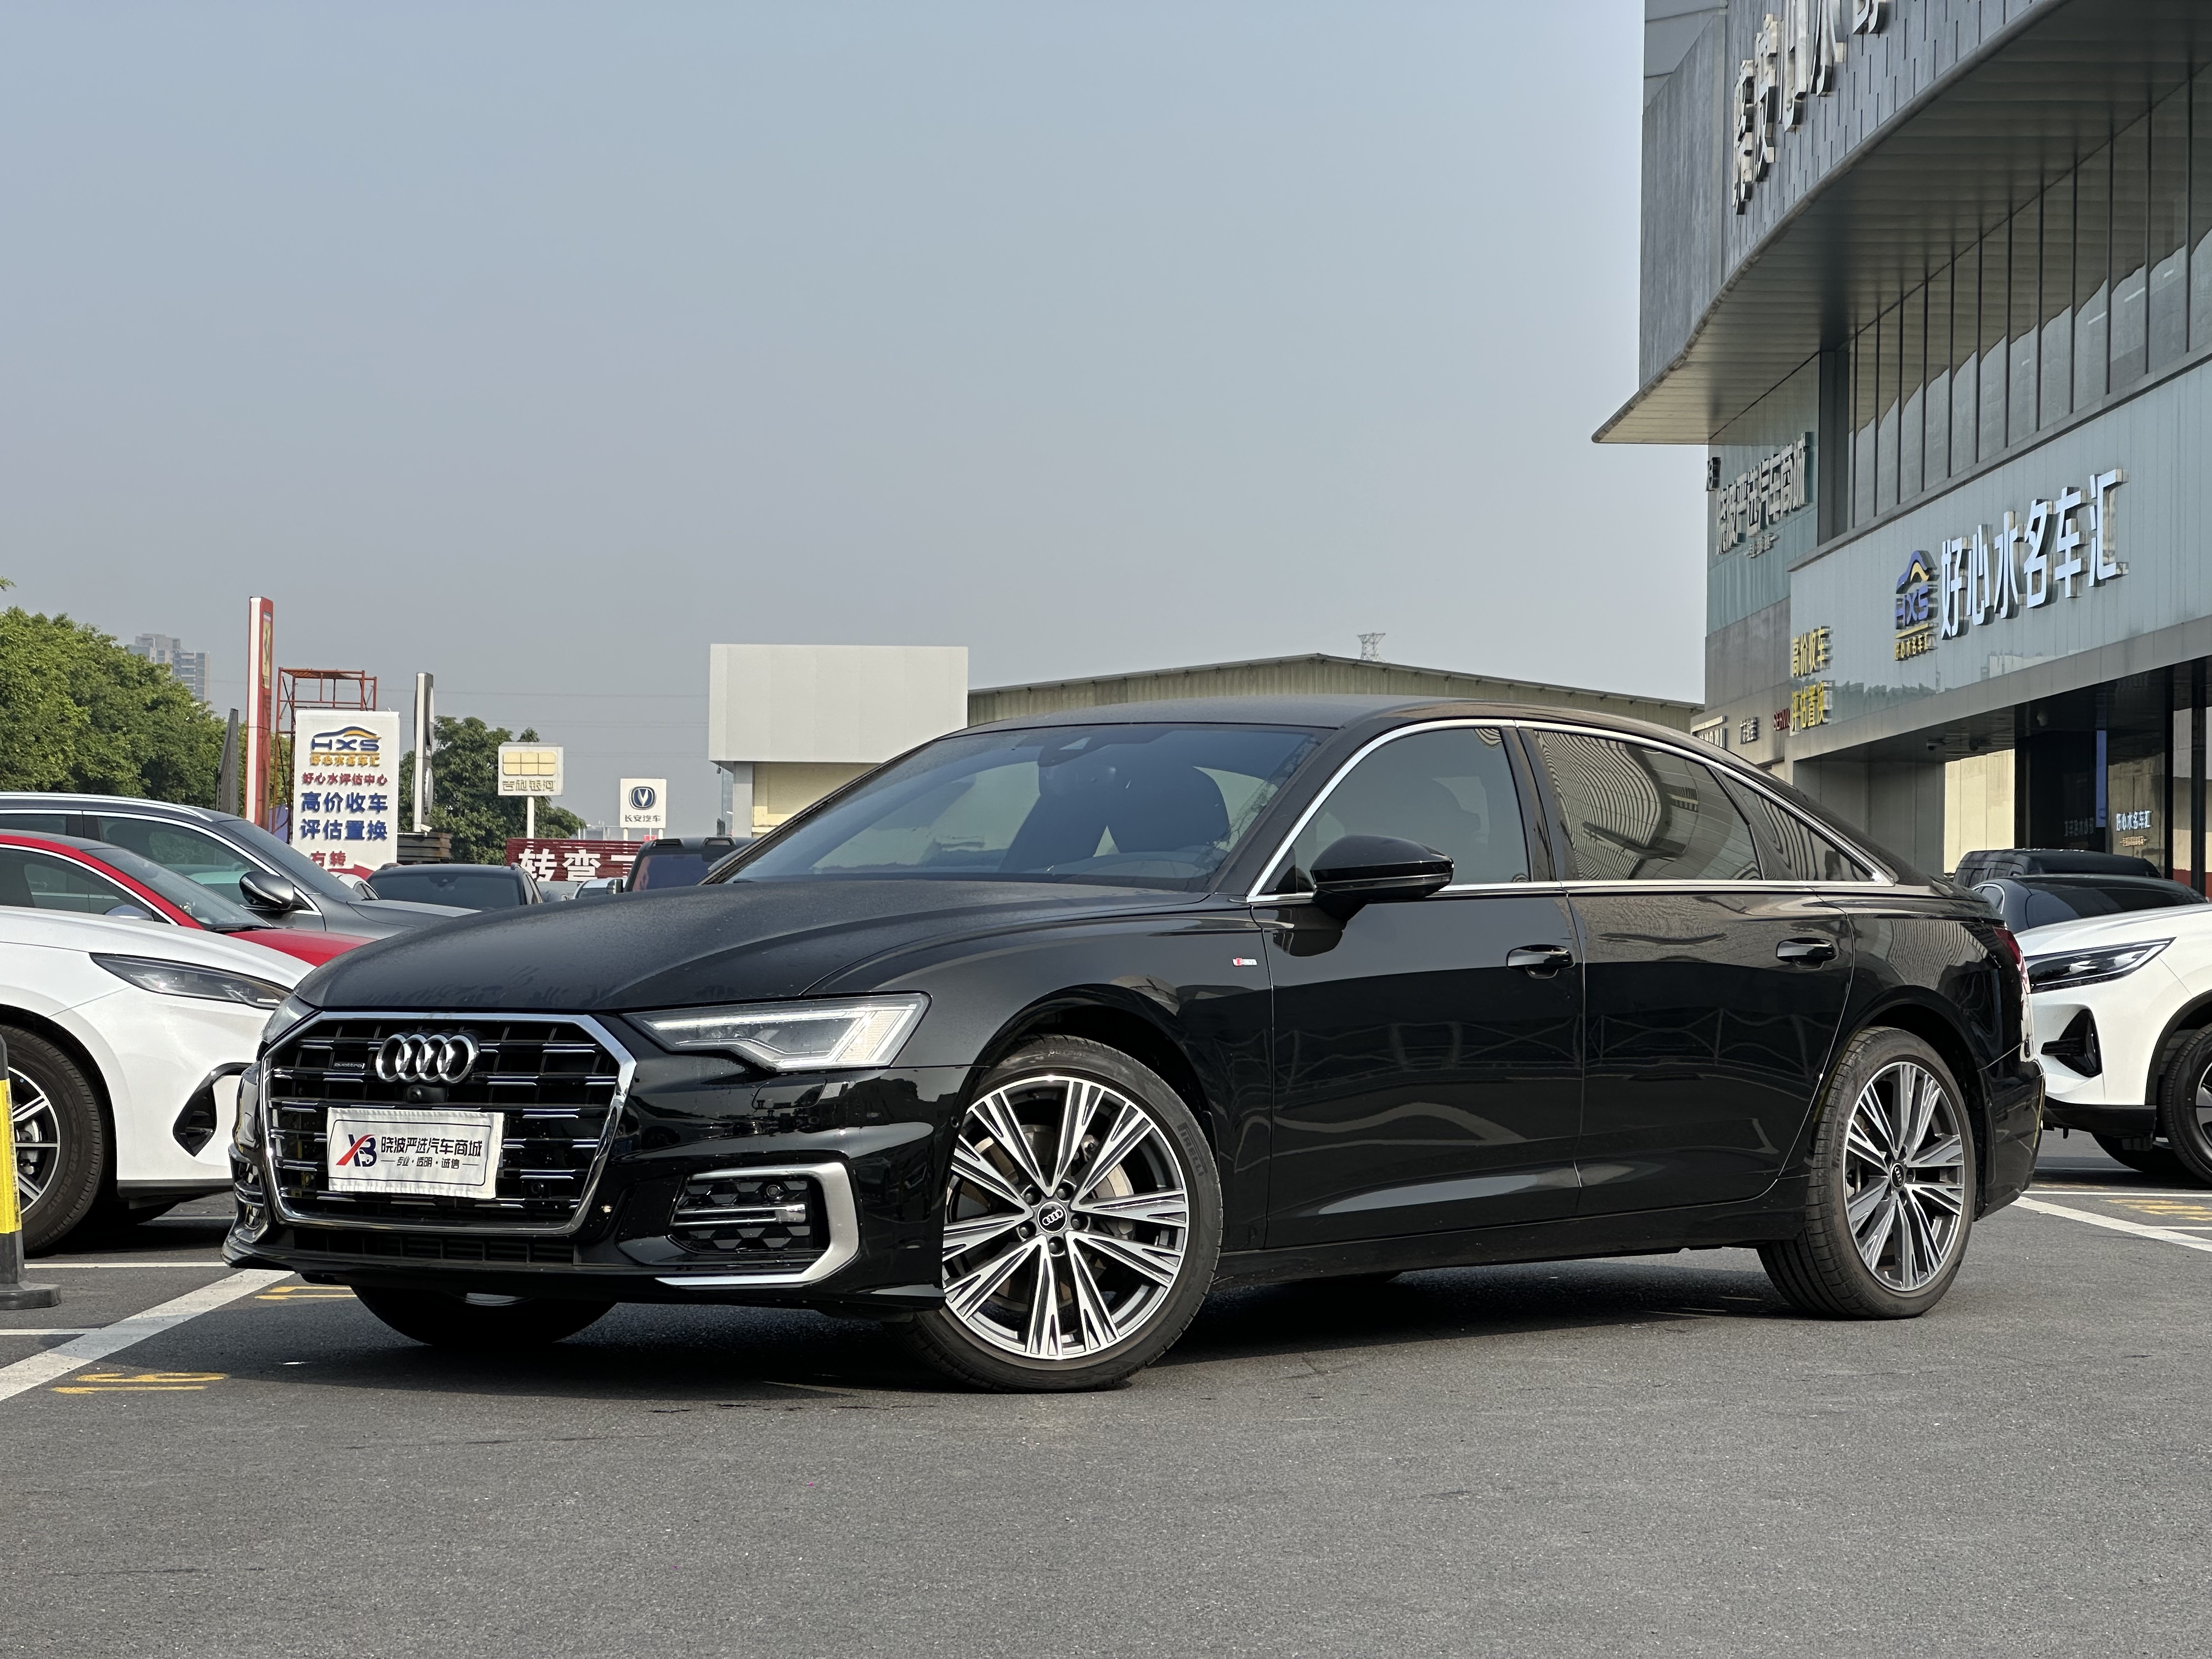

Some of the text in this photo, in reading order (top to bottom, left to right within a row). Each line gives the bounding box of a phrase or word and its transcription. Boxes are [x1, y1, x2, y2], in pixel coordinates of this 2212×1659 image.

[1940, 470, 2125, 640] 好心水名车汇
[1895, 585, 1930, 629] HXS
[311, 738, 380, 751] HXS
[302, 772, 388, 786] 好心水评估中心
[503, 780, 555, 791] 吉利银河
[301, 792, 388, 814] 高价收车
[300, 819, 388, 841] 评估置换
[311, 851, 346, 867] 右转
[518, 849, 636, 882] 转弯
[381, 1136, 483, 1156] 晓波严选汽车商城
[1177, 1122, 1208, 1176] PIRELLI
